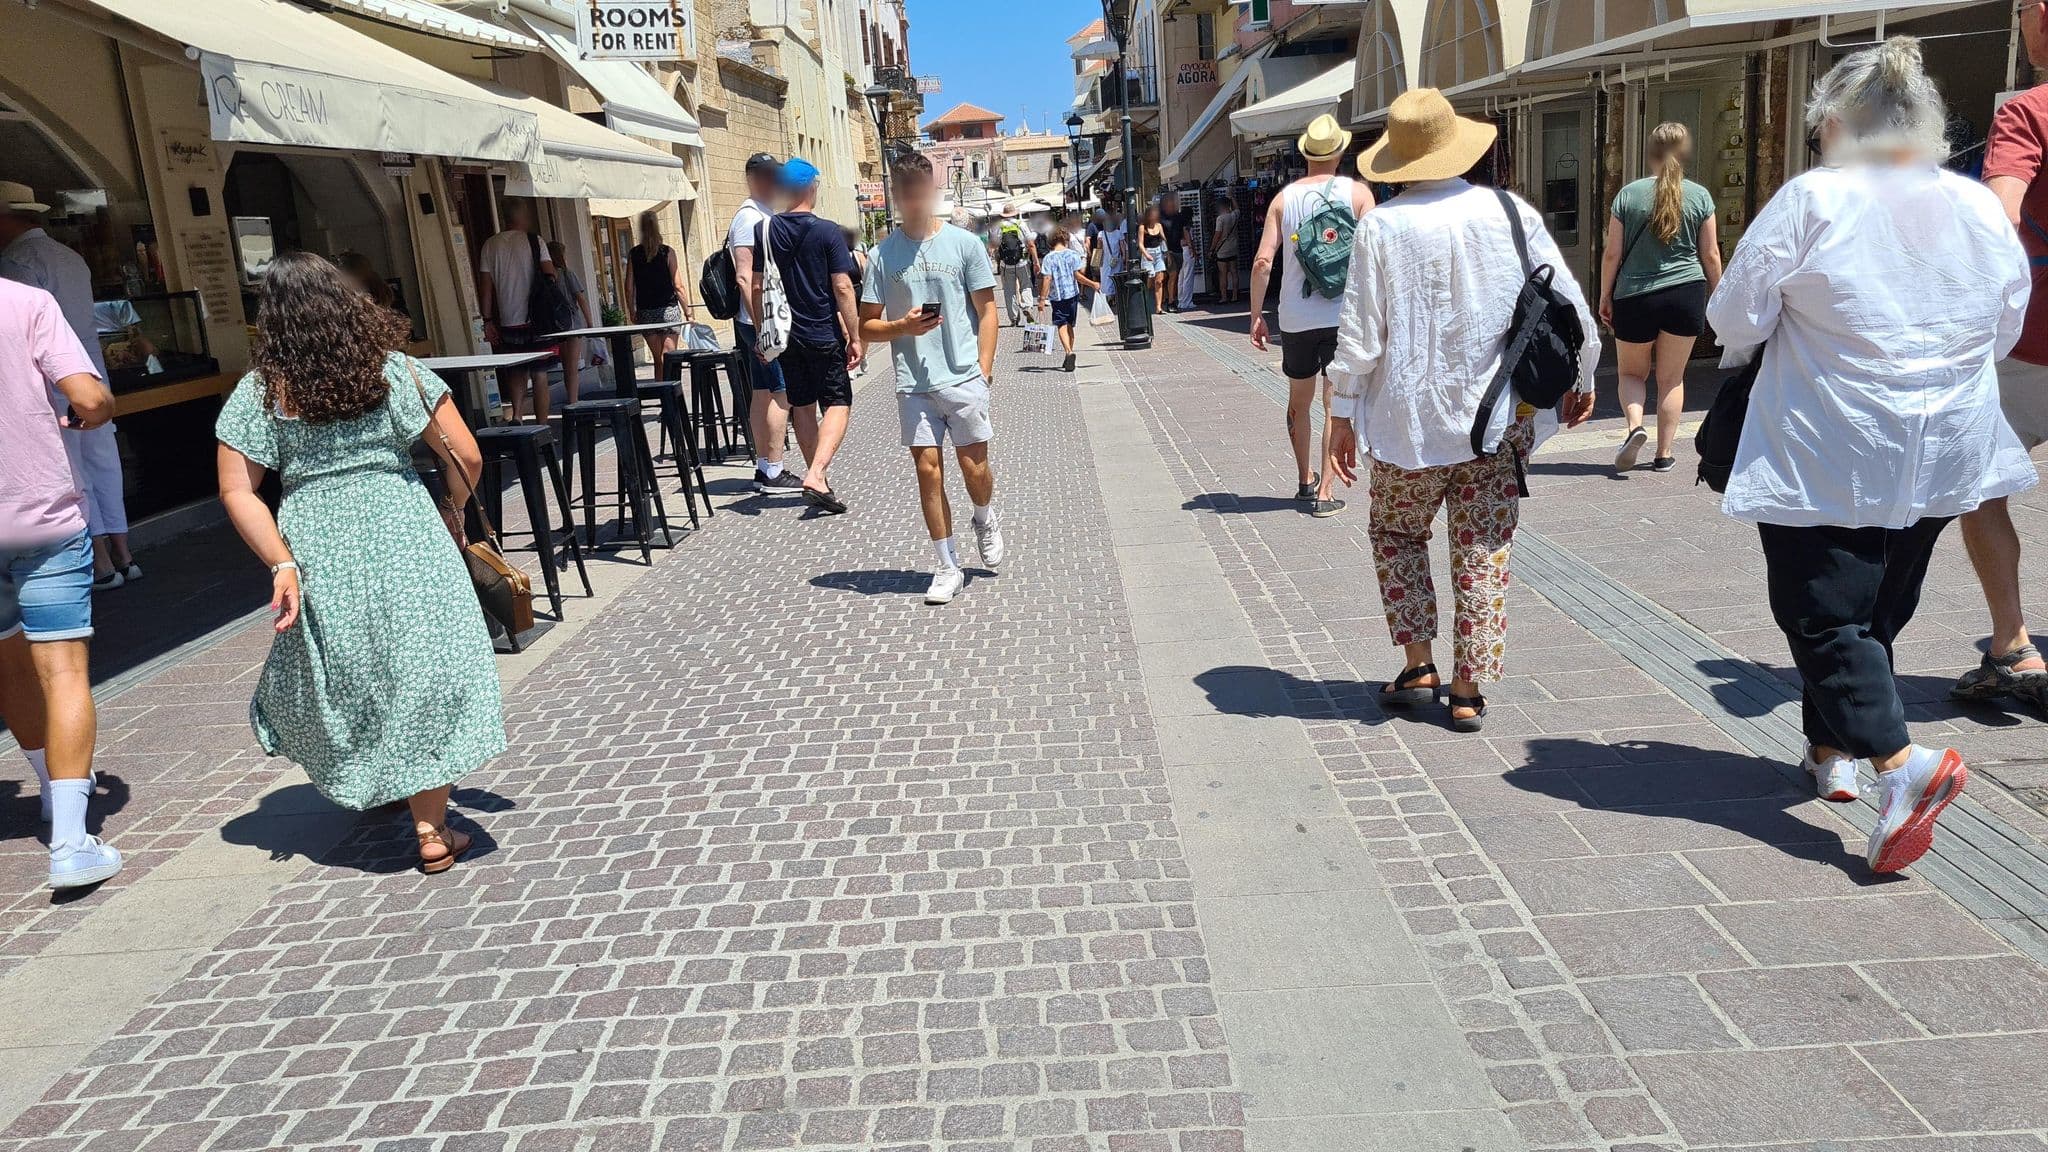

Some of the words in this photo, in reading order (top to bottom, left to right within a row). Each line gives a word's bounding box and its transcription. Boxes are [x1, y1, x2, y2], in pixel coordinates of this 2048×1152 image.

[590, 8, 687, 28] ROOMS
[592, 32, 627, 50] FOR
[633, 32, 678, 50] RENT
[1177, 70, 1217, 85] AGORA
[261, 80, 328, 125] CREAM
[891, 267, 909, 283] LOS
[912, 262, 958, 277] ANGELES
